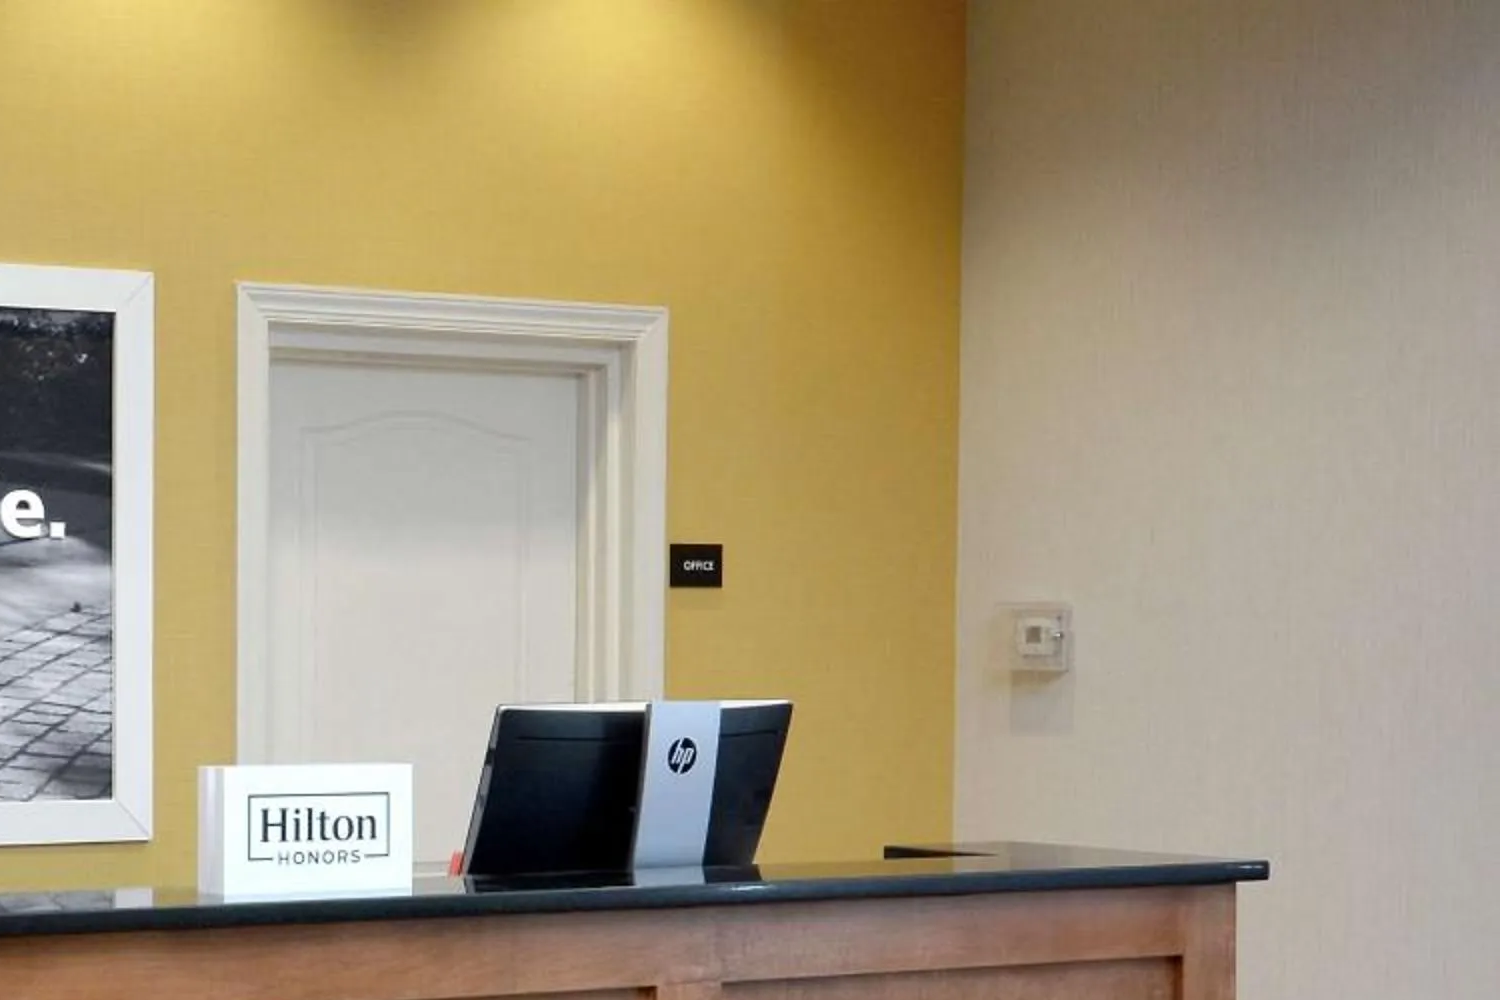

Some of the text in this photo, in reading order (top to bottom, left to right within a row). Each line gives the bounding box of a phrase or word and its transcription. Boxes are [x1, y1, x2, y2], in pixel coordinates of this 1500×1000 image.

[670, 737, 695, 774] hp
[260, 807, 377, 843] Hilton
[277, 849, 361, 866] HONORS
